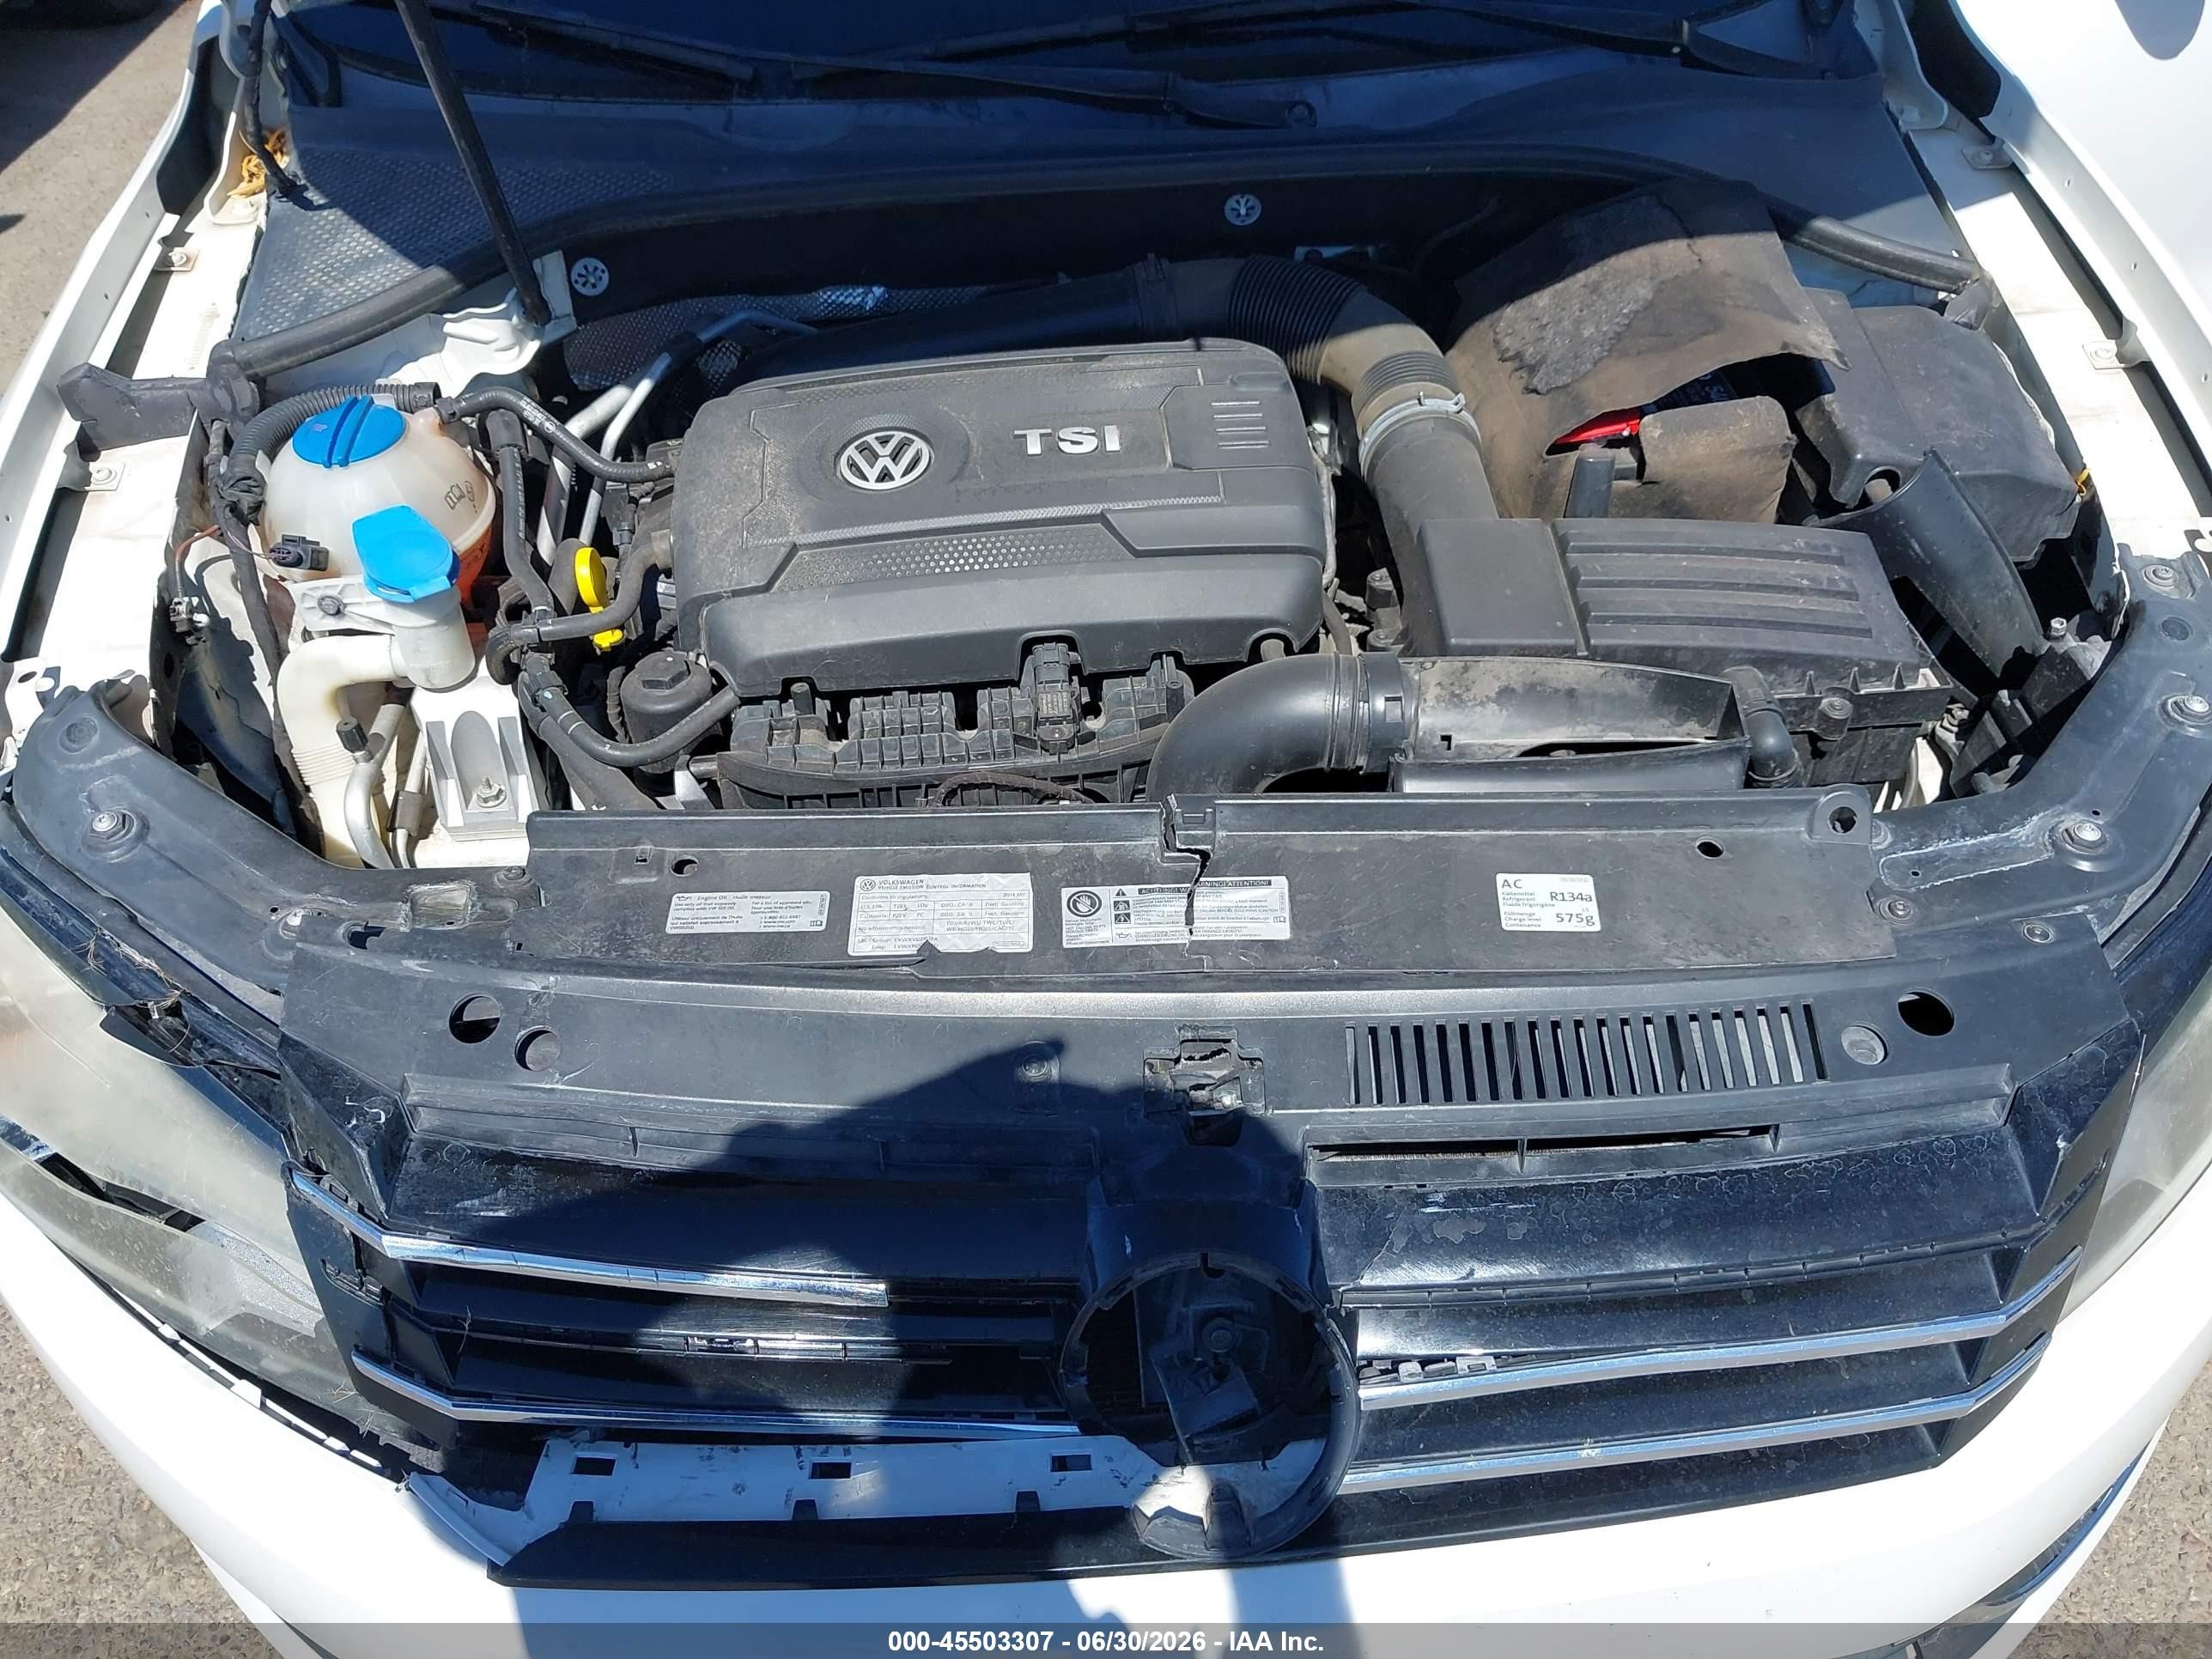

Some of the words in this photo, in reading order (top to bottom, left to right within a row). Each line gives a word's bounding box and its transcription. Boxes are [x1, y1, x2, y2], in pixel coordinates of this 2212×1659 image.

[1014, 426, 1121, 455] TSI
[1502, 879, 1523, 889] AC
[1550, 891, 1593, 902] R134a
[1556, 913, 1595, 927] 575g
